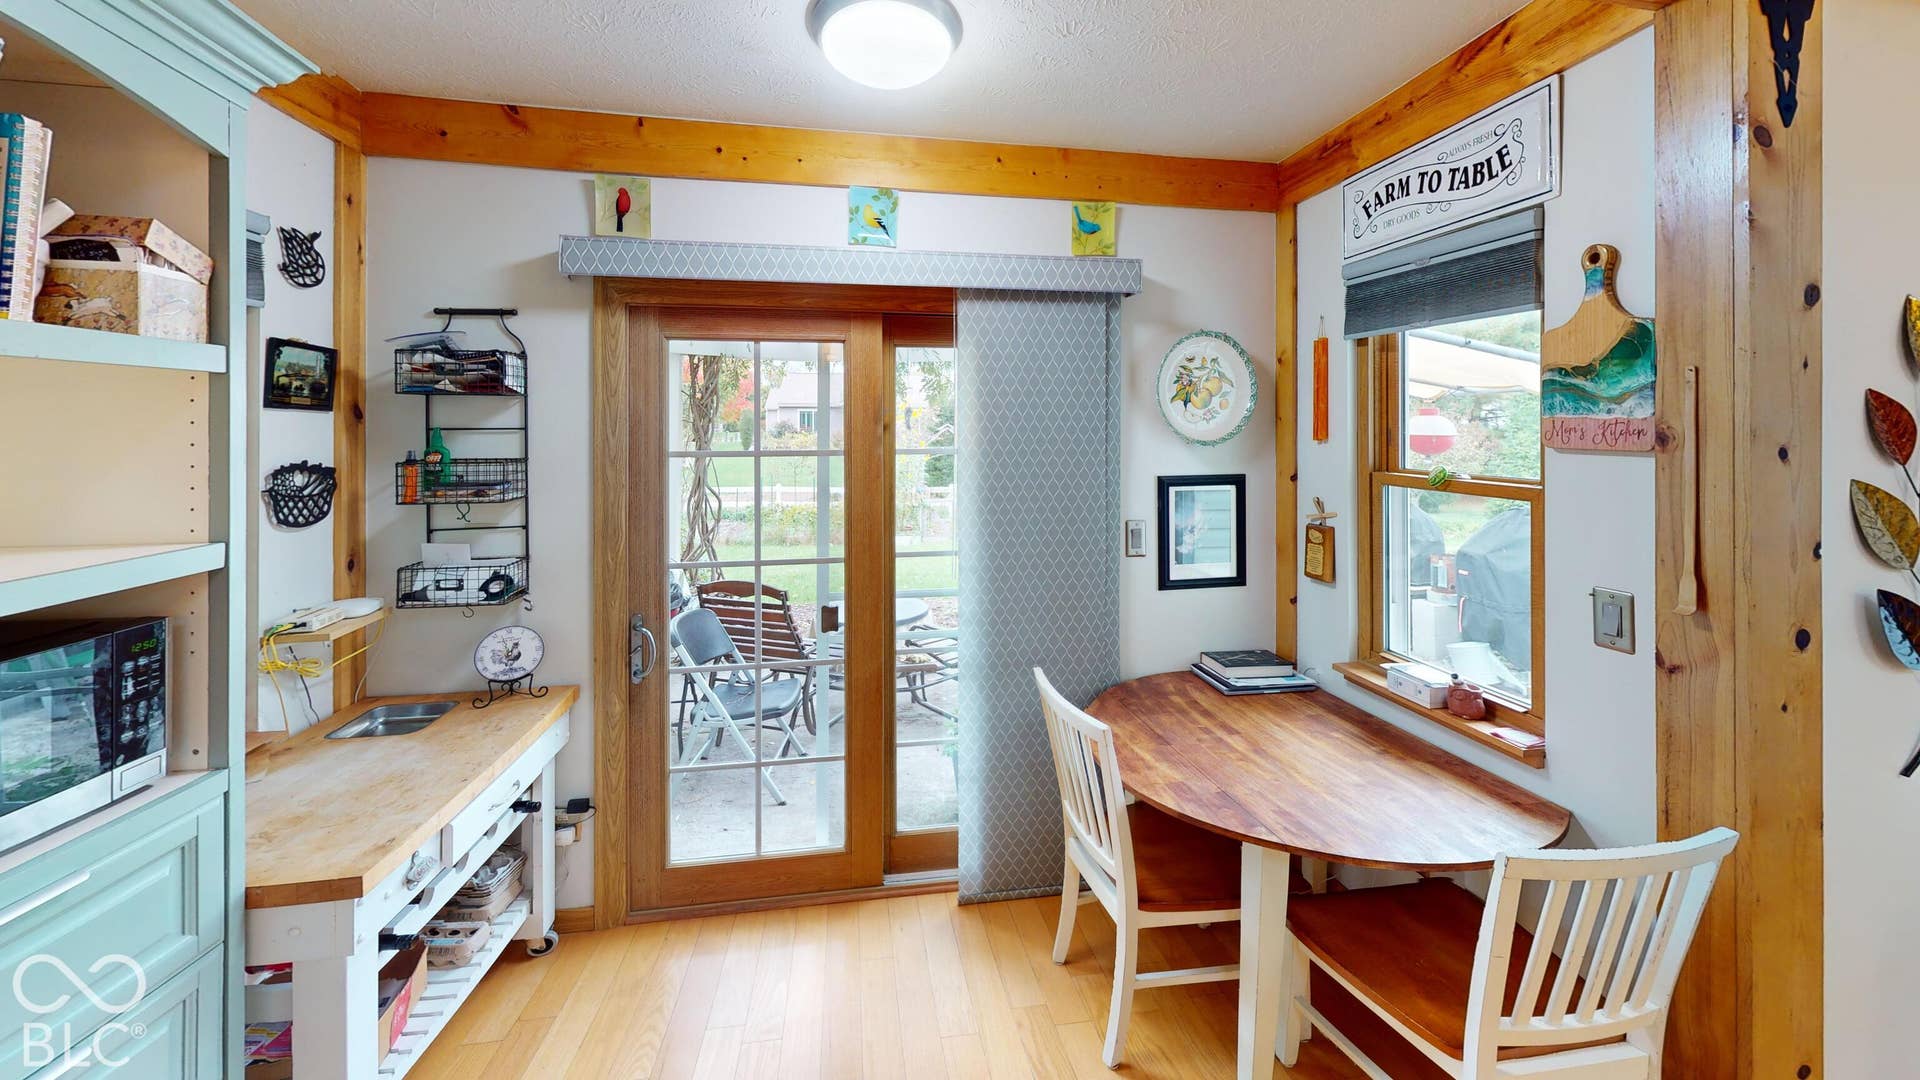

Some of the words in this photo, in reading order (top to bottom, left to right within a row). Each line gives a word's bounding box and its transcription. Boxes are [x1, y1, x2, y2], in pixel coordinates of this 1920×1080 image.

[1472, 130, 1494, 147] FRESH
[1361, 175, 1411, 220] FARM
[1417, 169, 1442, 194] TO
[1447, 144, 1514, 192] TABLE
[1383, 216, 1395, 230] DRY
[1396, 209, 1421, 226] GOODS
[1592, 419, 1648, 447] Kitchen
